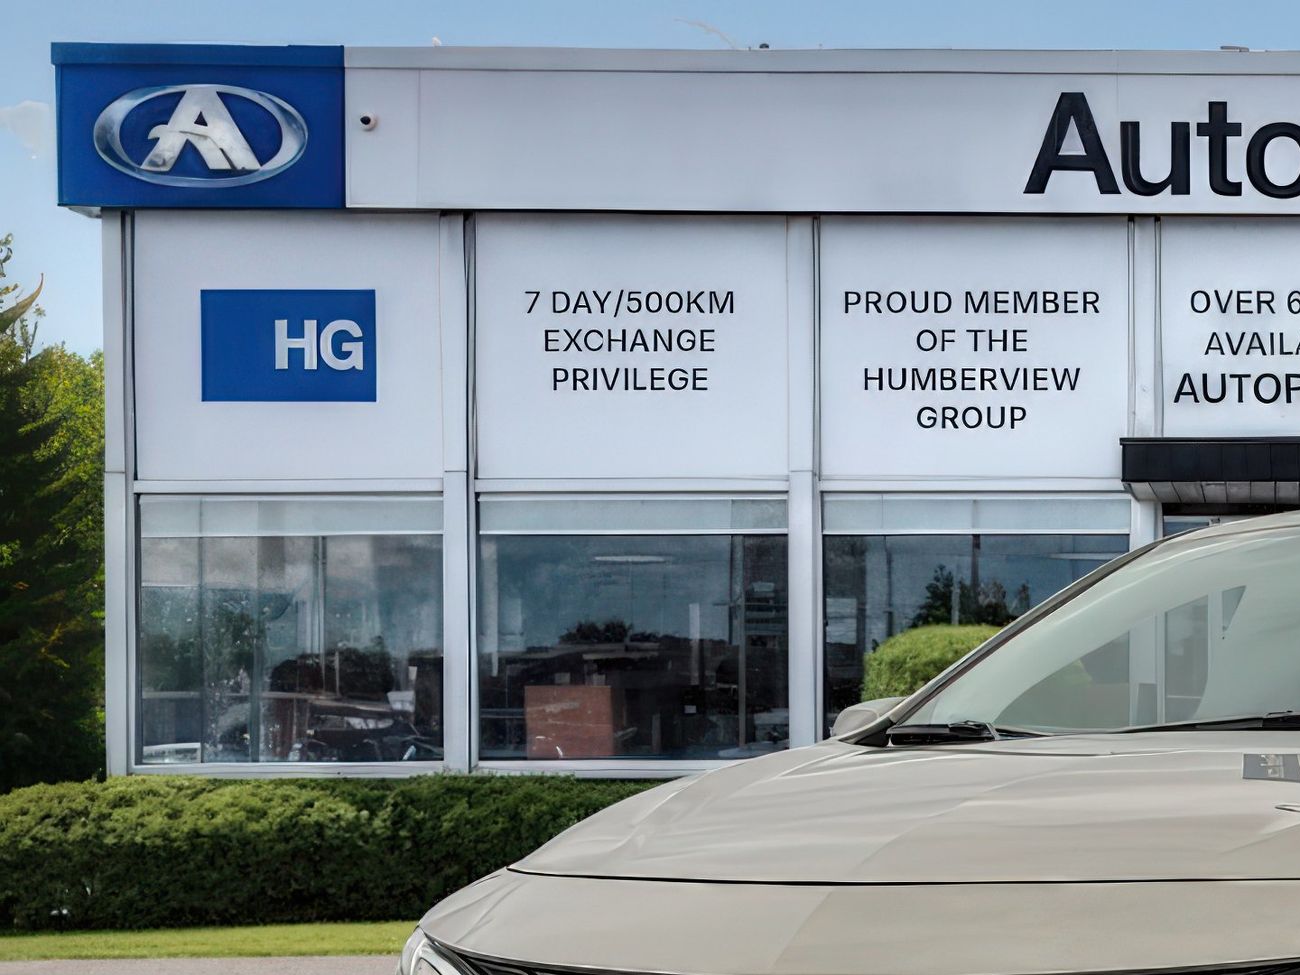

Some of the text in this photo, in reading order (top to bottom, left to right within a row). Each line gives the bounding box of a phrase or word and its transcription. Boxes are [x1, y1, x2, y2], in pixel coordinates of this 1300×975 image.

[524, 289, 735, 318] 7 DAY/500KM
[844, 290, 1100, 314] PROUD MEMBER
[1190, 289, 1276, 315] OVER
[273, 319, 364, 371] HG
[544, 328, 716, 353] EXCHANGE
[916, 328, 1028, 353] OF THE
[552, 367, 709, 392] PRIVILEGE
[863, 367, 1081, 391] HUMBERVIEW
[916, 405, 1027, 430] GROUP
